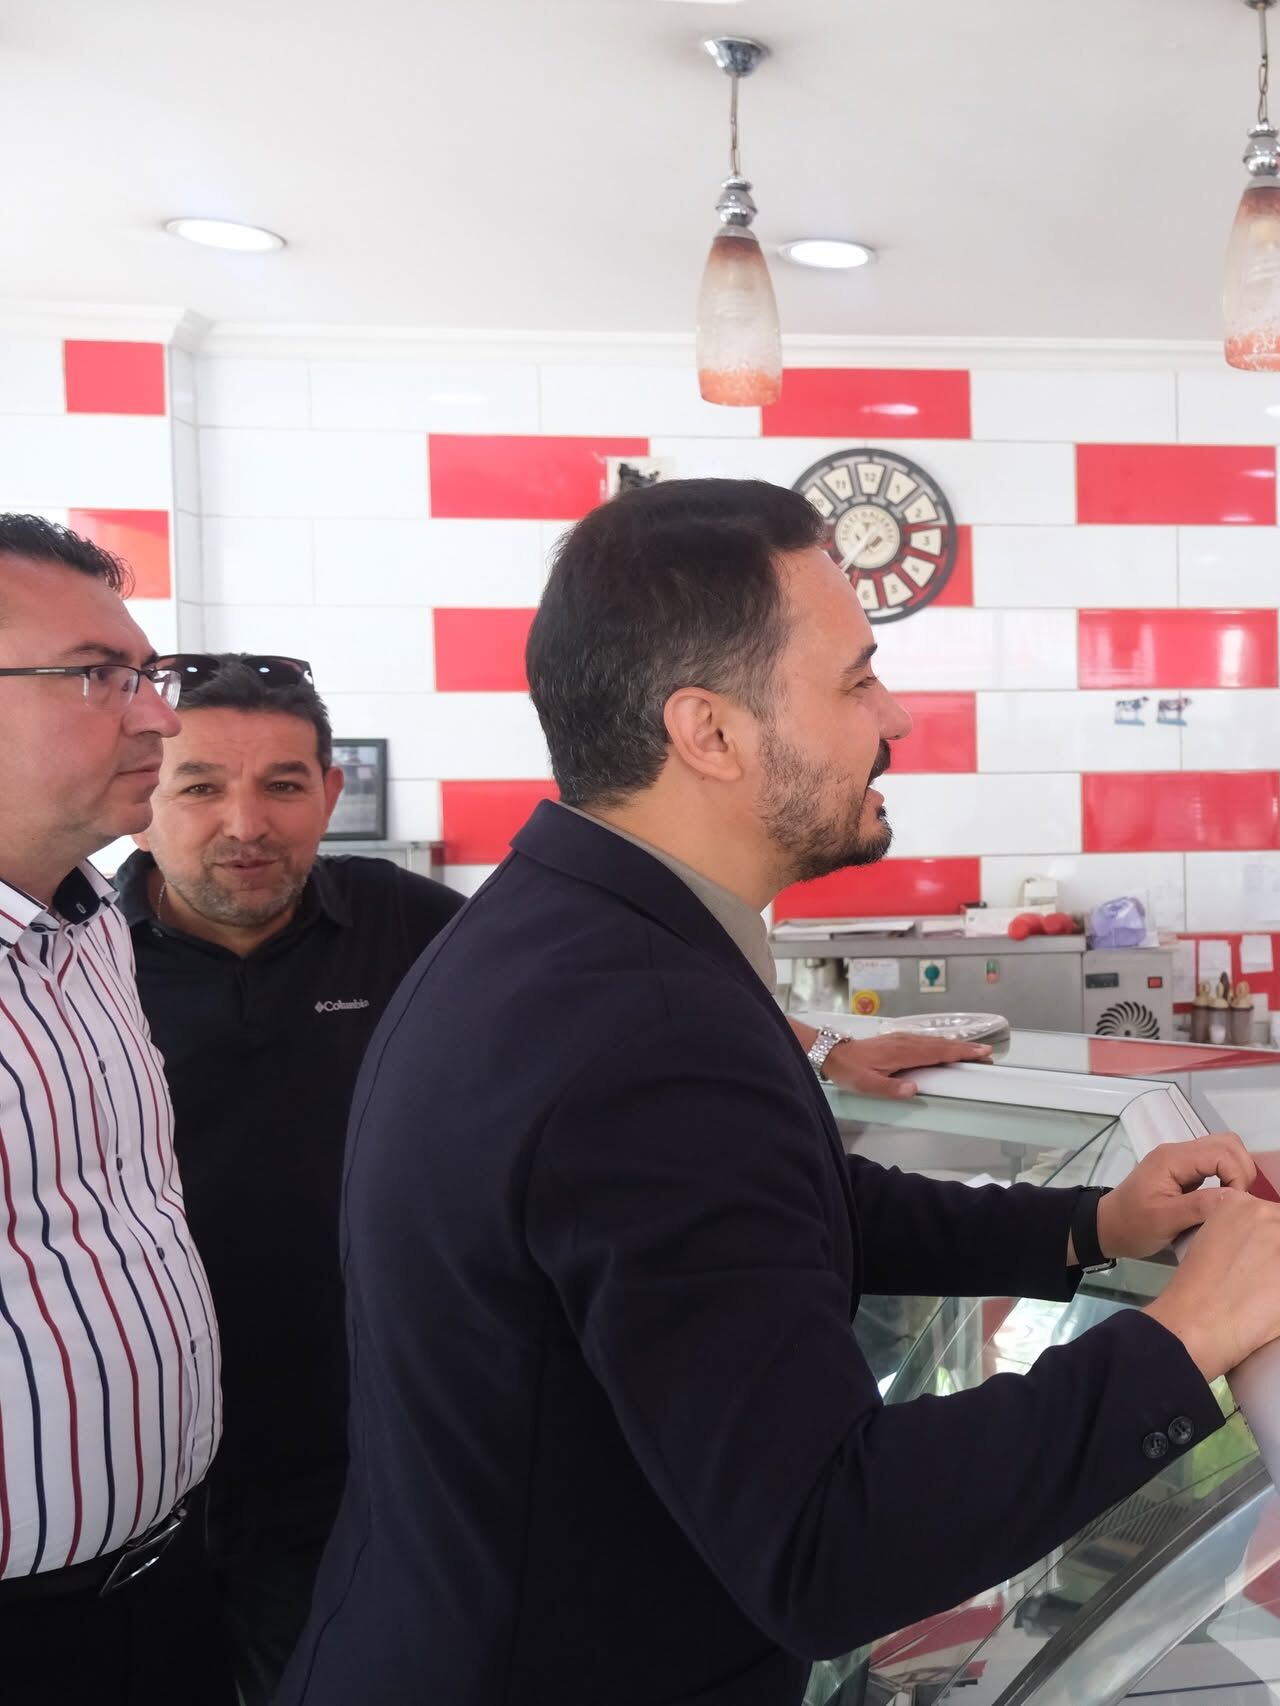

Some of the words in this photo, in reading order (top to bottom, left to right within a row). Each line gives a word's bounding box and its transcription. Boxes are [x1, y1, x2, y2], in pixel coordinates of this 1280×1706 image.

[863, 472, 876, 483] 12
[835, 479, 847, 490] 11
[323, 998, 370, 1012] Columbia
